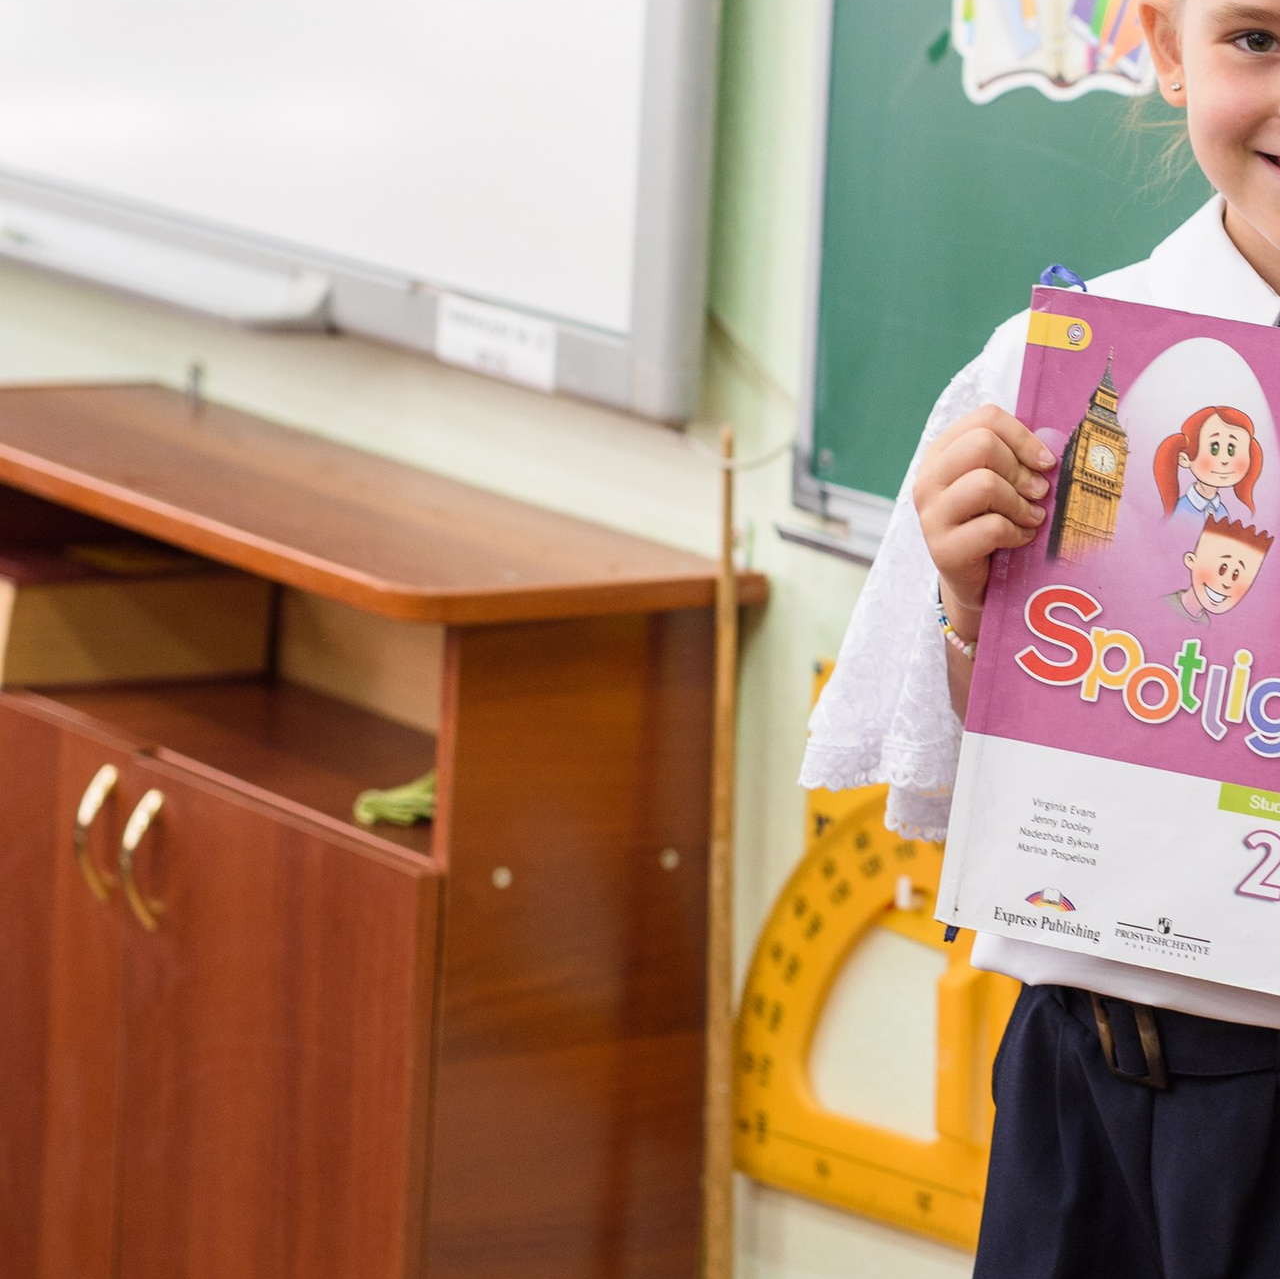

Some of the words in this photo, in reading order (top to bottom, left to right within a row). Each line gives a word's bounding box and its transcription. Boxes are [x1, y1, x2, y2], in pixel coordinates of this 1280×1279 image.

[1032, 797, 1067, 812] Virginia
[1070, 805, 1097, 819] Evans
[1030, 814, 1058, 828] Jenny
[1061, 819, 1093, 835] Dooley
[1020, 826, 1064, 843] Nadezhda
[1067, 836, 1099, 851] Bykova
[1017, 842, 1048, 856] Marina
[1051, 848, 1097, 866] Pospelova
[994, 906, 1038, 929] Express
[1041, 916, 1101, 944] Publishing
